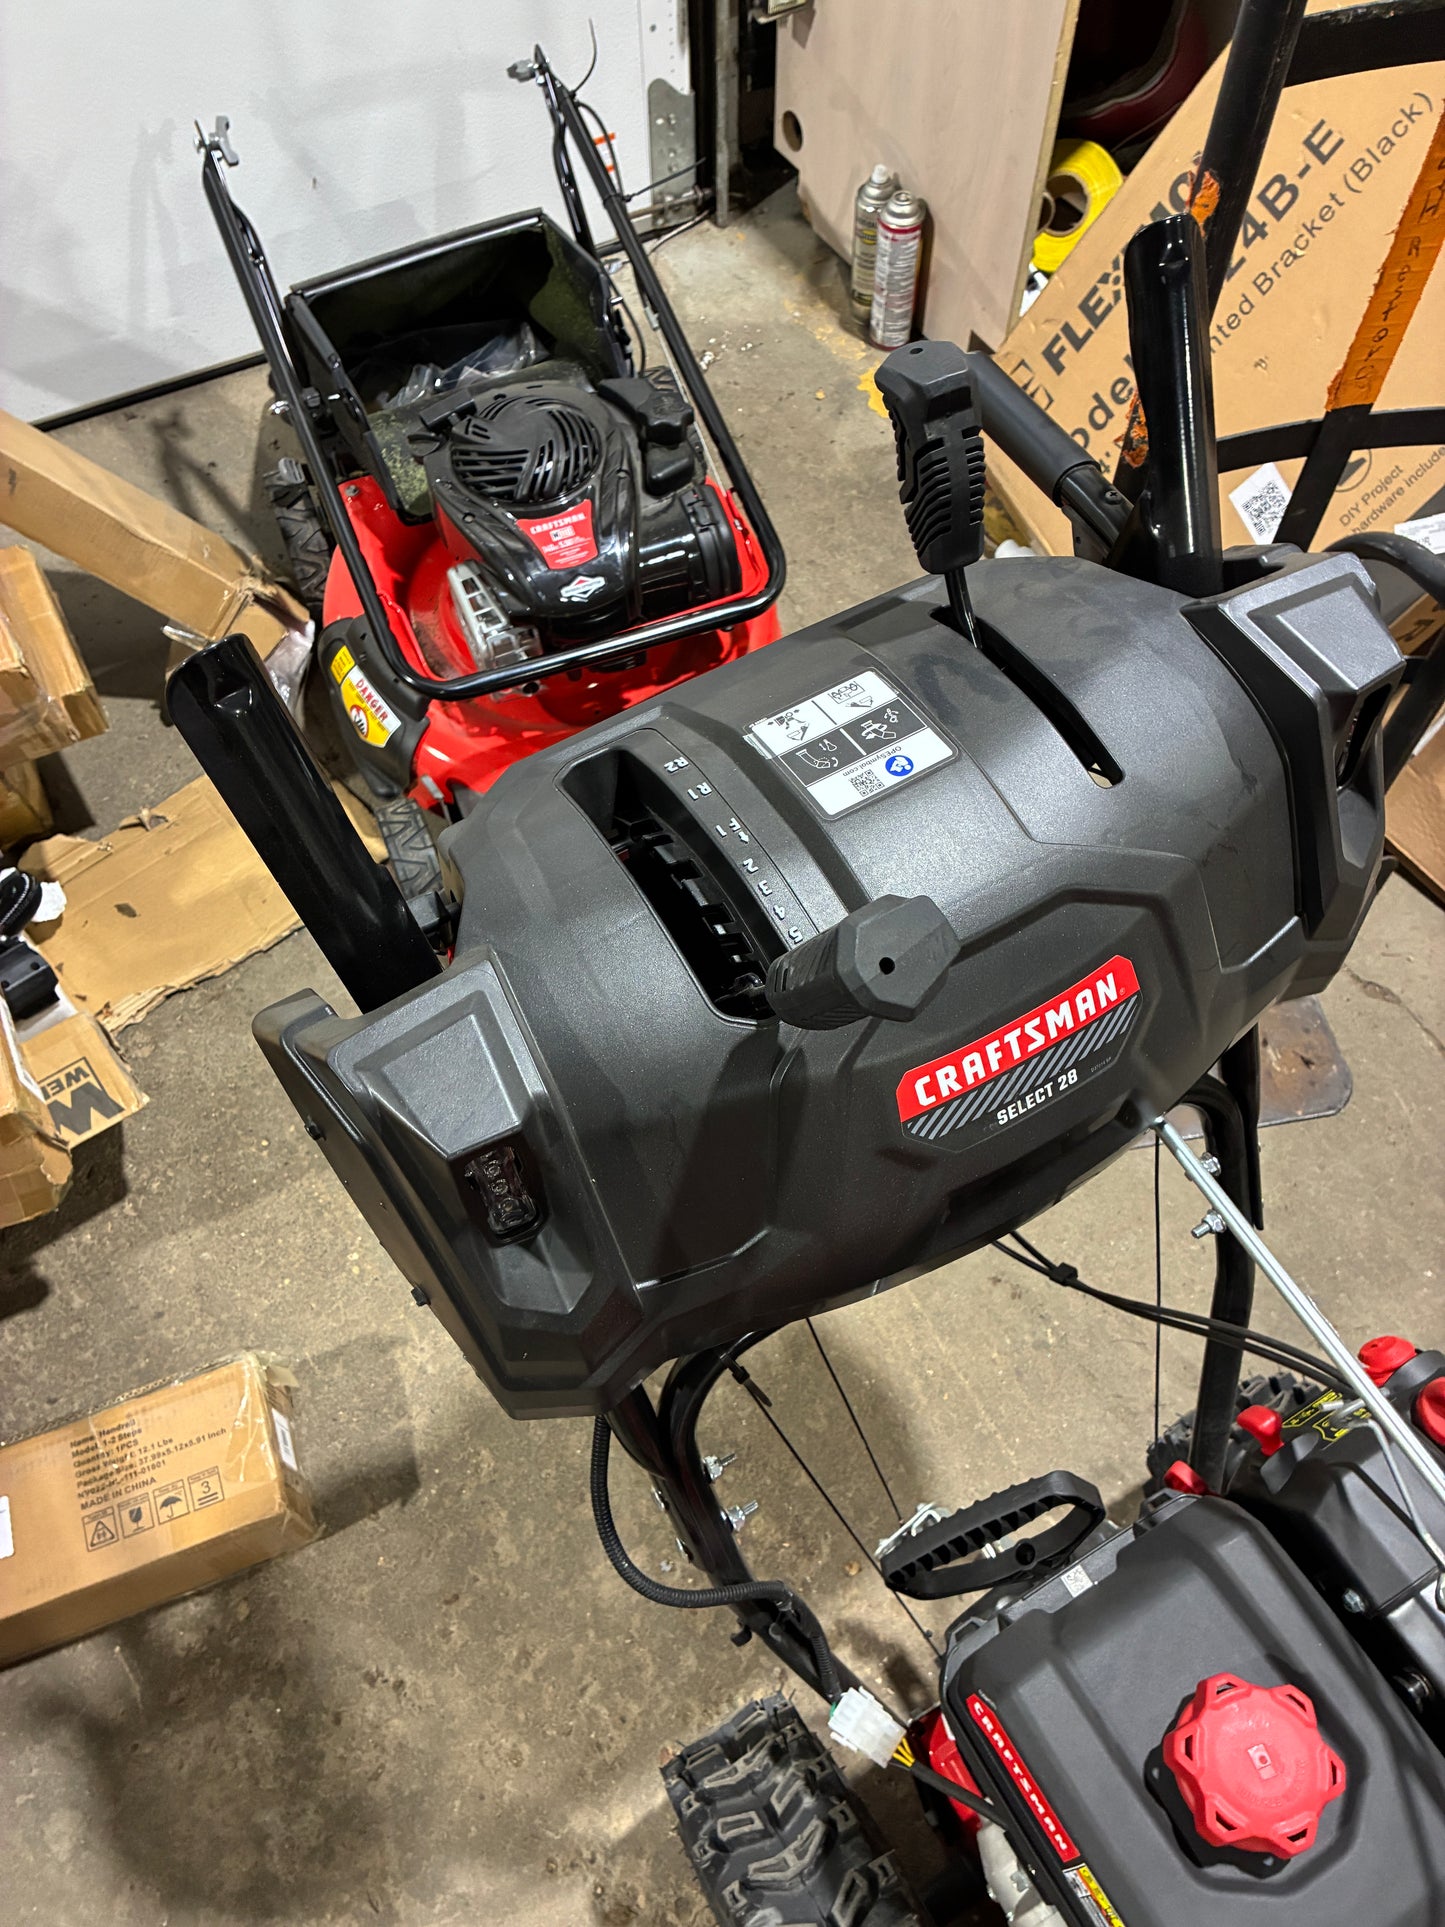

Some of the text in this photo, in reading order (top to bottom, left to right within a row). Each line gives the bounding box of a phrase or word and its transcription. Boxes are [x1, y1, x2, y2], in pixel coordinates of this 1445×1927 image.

[1209, 92, 1433, 354] nted Bracket (Black)
[1339, 465, 1404, 527] DIY Project
[355, 678, 389, 723] DANGER
[664, 756, 689, 774] R2
[743, 858, 758, 873] 2
[758, 879, 773, 896] 3
[773, 904, 786, 920] 4
[788, 925, 804, 943] 5
[914, 971, 1118, 1107] CRAFTSMAN
[996, 1068, 1078, 1125] SELECT 28
[116, 1439, 139, 1453] 1PCS
[80, 1495, 111, 1510] MADE
[112, 1489, 123, 1500] IN
[124, 1476, 157, 1494] CHINA
[973, 1701, 1068, 1851] CRAFTSMAN
